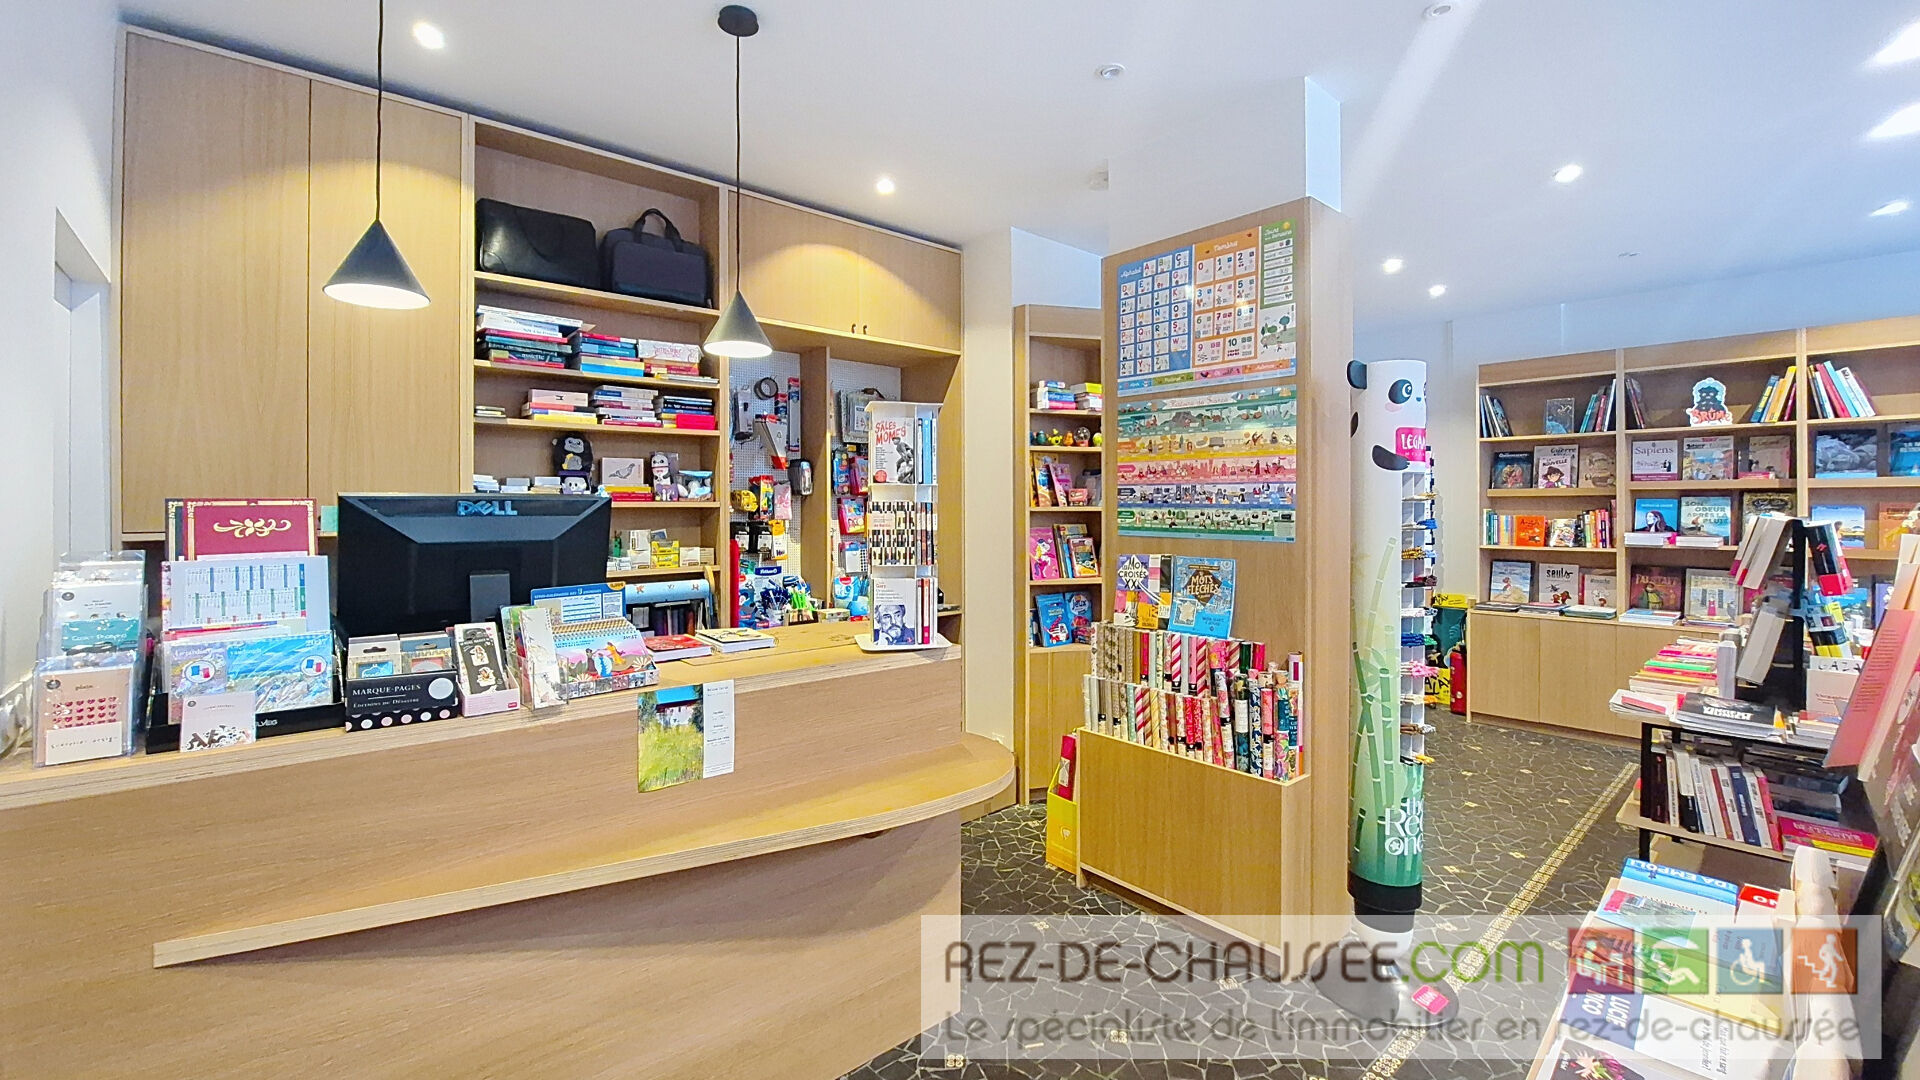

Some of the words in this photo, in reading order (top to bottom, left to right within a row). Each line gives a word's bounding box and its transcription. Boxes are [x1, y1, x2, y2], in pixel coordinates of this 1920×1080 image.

[1634, 446, 1673, 456] Sapiens
[457, 500, 518, 516] DELL
[1191, 575, 1212, 585] MOTS
[352, 684, 421, 696] MARQUE-PAGES
[1631, 859, 1697, 881] EMPOLI
[1701, 875, 1727, 888] DA
